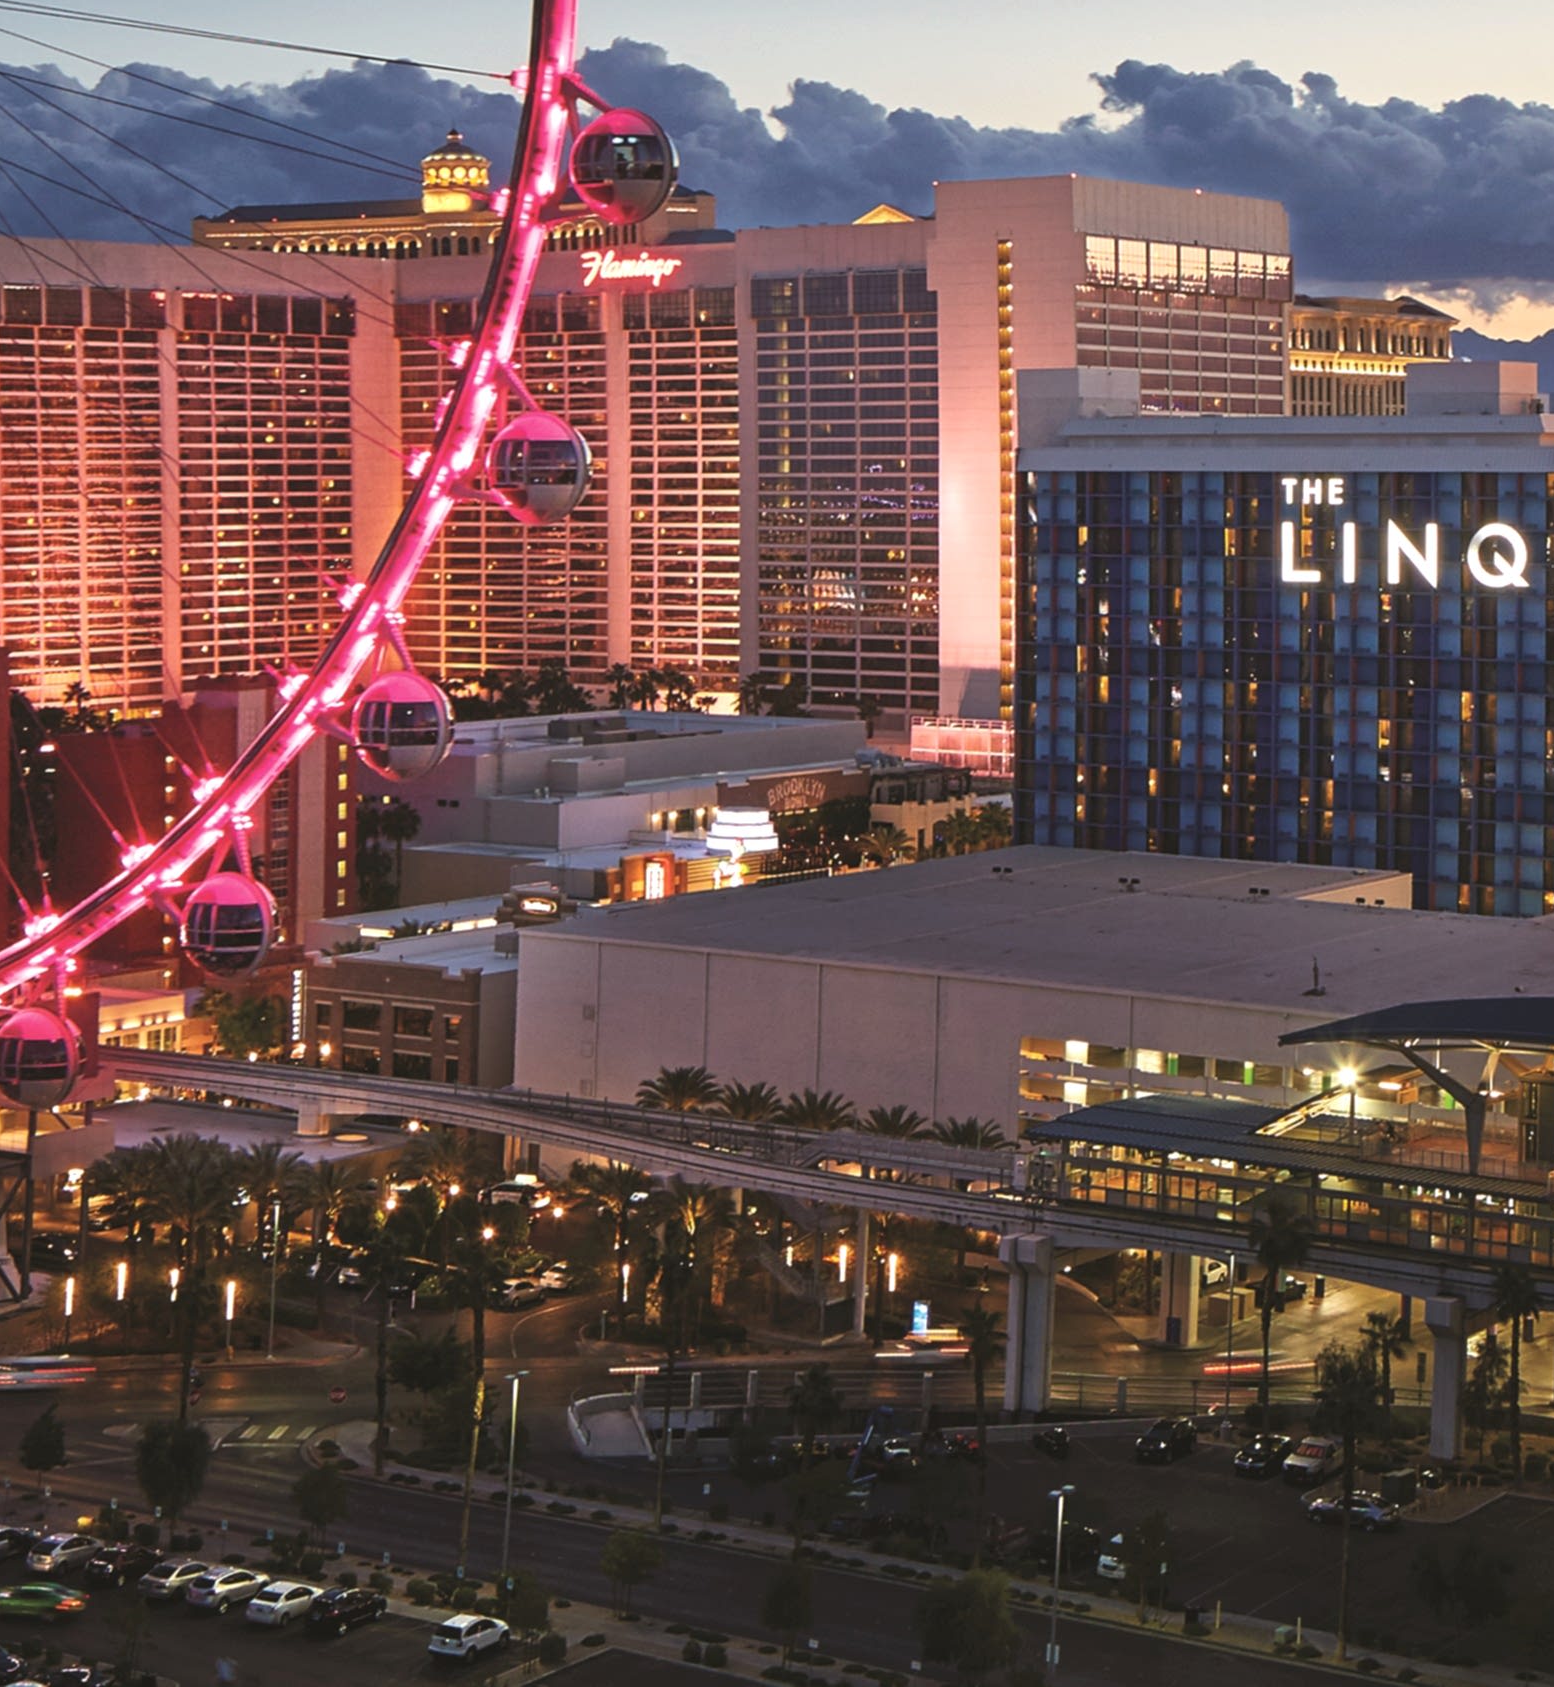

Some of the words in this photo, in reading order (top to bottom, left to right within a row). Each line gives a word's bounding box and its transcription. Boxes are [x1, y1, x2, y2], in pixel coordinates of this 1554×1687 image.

[580, 250, 682, 287] Flamingo
[1281, 478, 1344, 505] THE
[1280, 518, 1530, 589] LINQ
[767, 777, 827, 806] BROOKLYN
